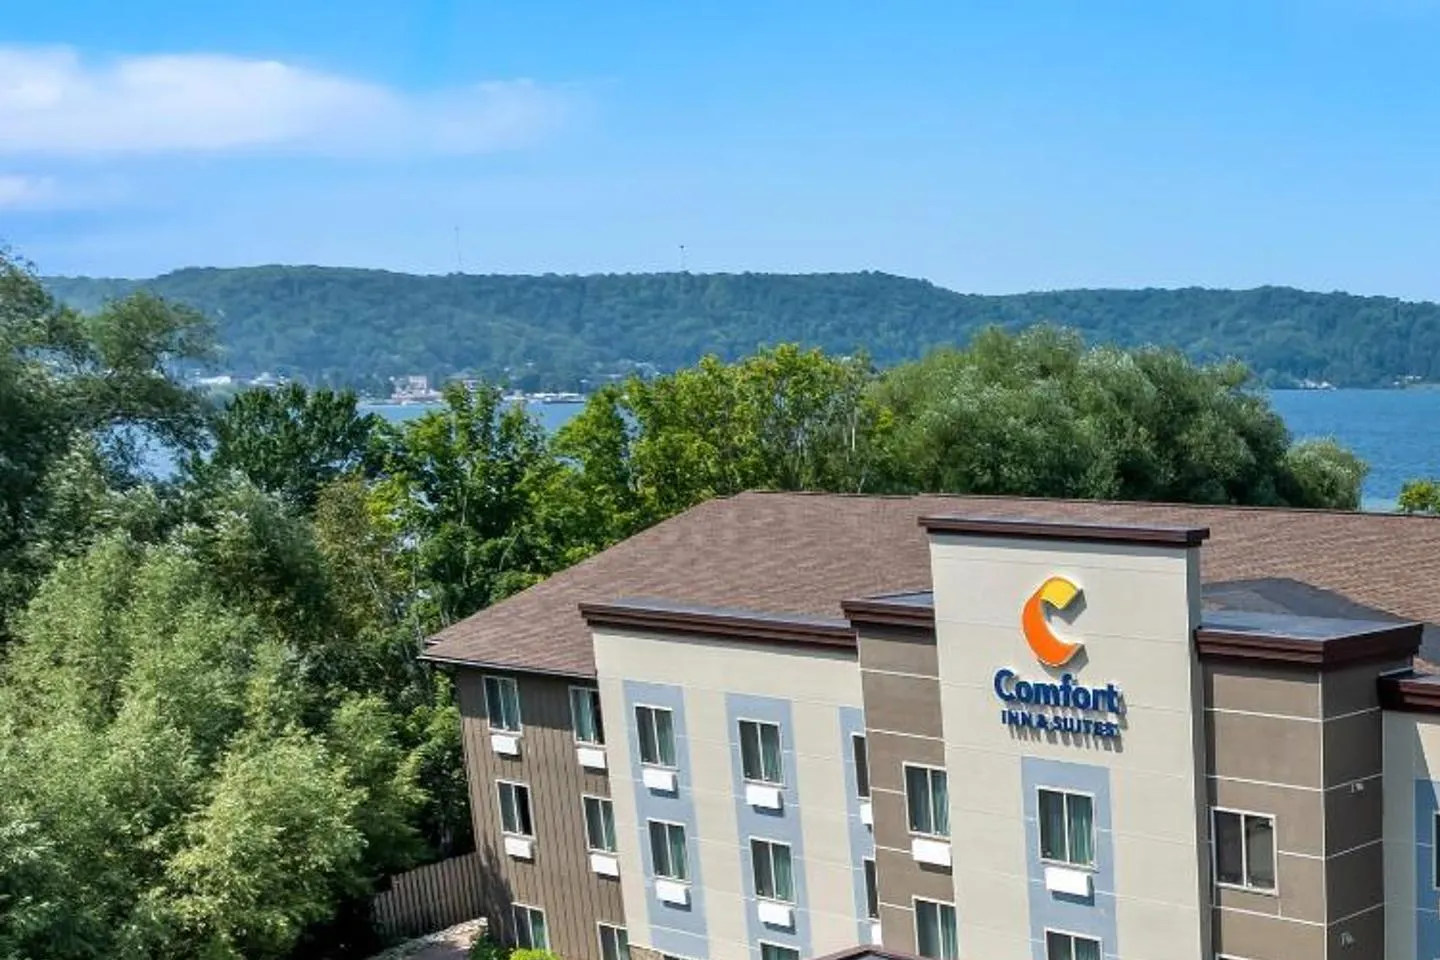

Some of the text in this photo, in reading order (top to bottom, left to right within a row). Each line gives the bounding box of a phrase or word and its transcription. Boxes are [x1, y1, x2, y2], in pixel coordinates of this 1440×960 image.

[994, 669, 1120, 714] Comfort
[1002, 709, 1118, 737] INN & SUITES
